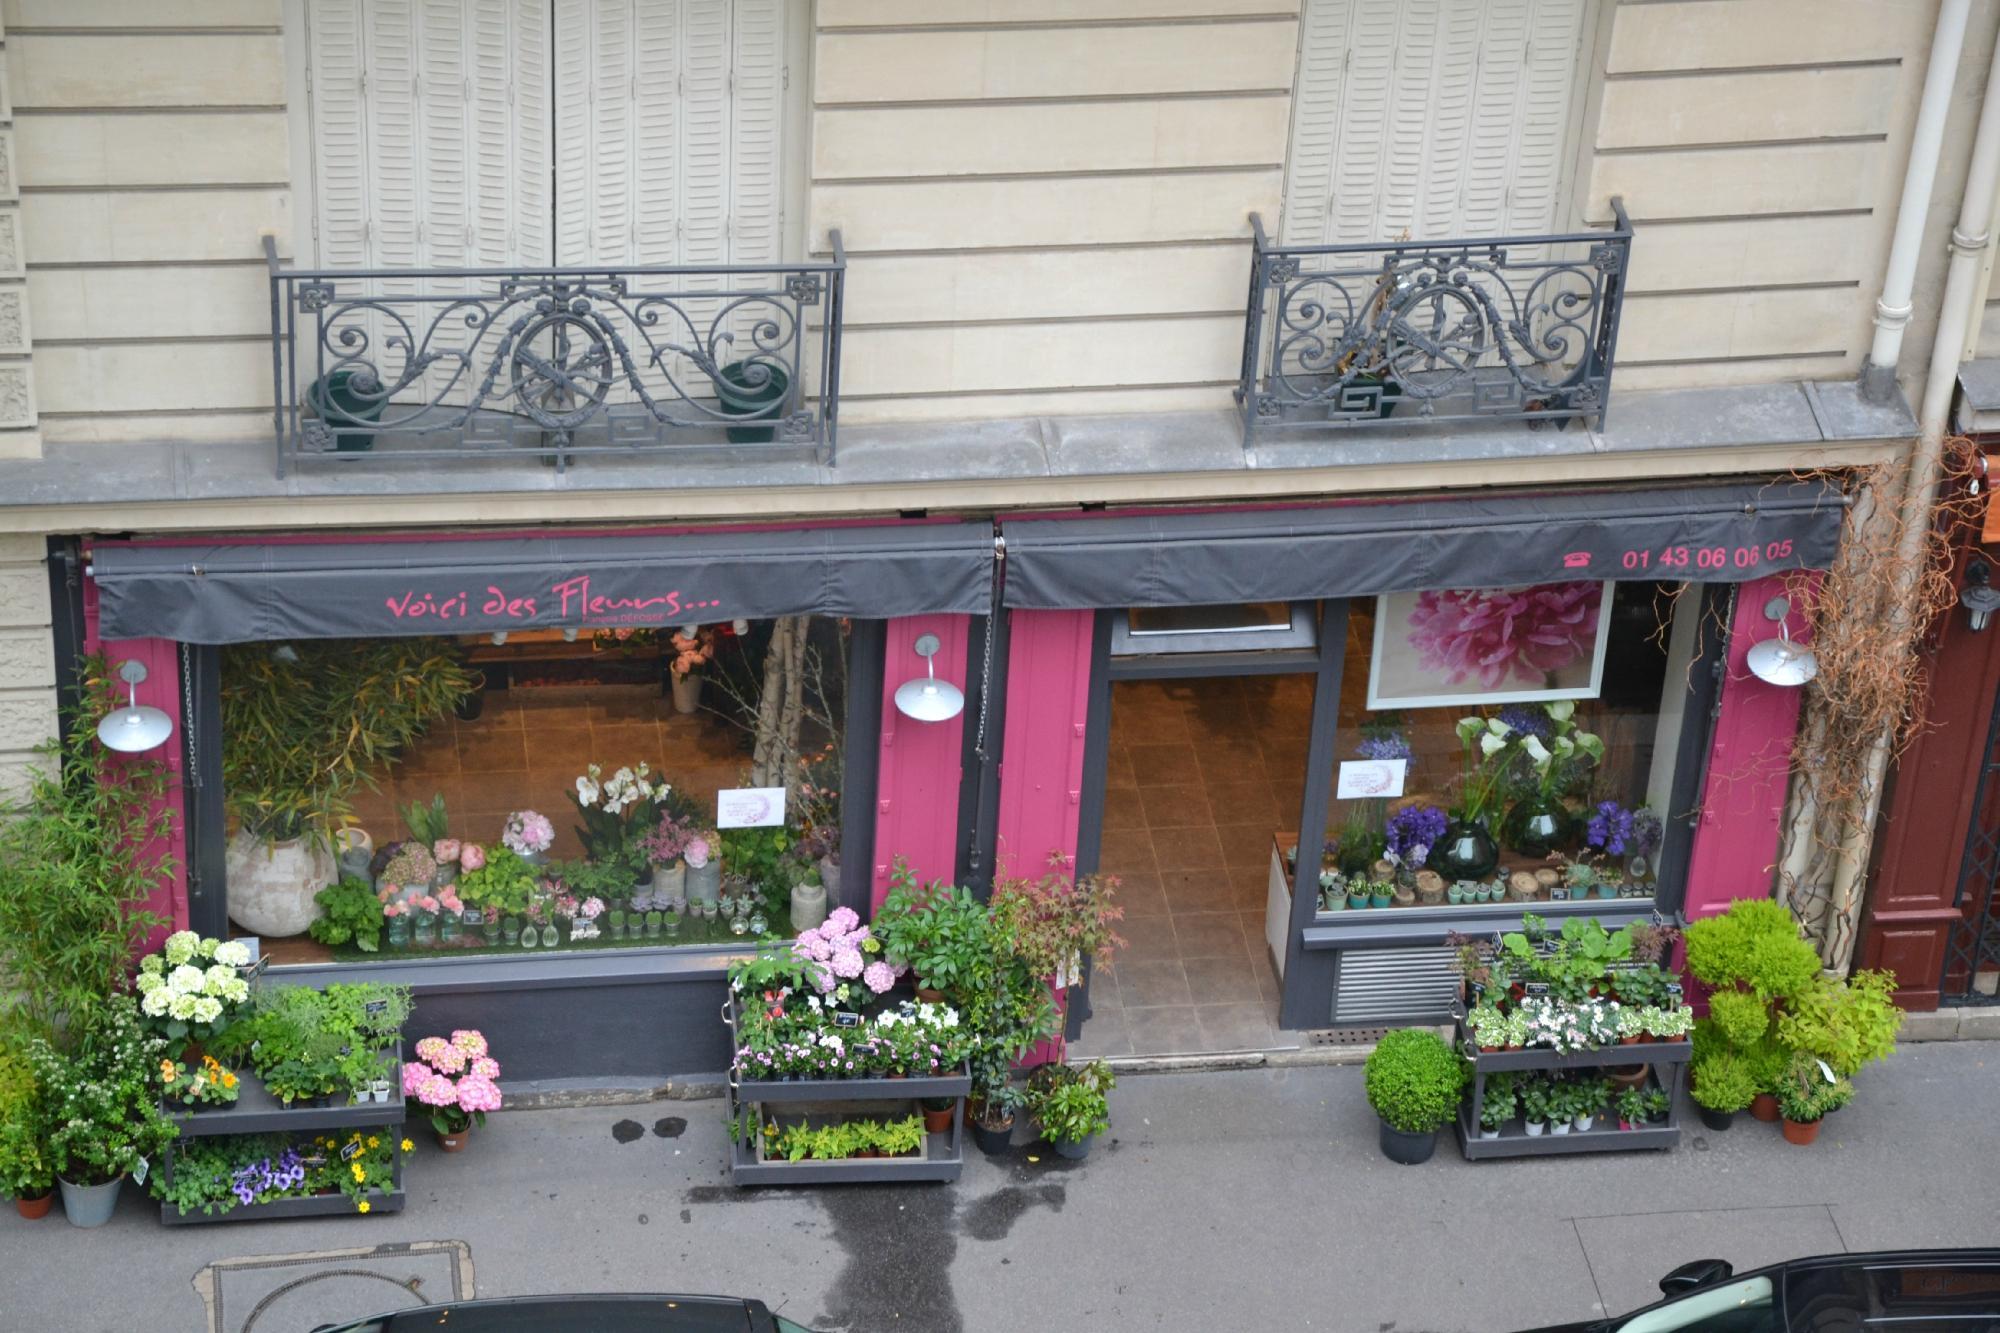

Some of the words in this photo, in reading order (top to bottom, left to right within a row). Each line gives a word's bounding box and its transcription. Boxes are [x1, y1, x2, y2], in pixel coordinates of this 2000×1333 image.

[1622, 550, 1649, 569] 01
[1659, 546, 1690, 566] 43
[1696, 547, 1727, 568] 06
[1734, 545, 1760, 568] 06
[1766, 539, 1793, 560] 05
[482, 585, 537, 618] des
